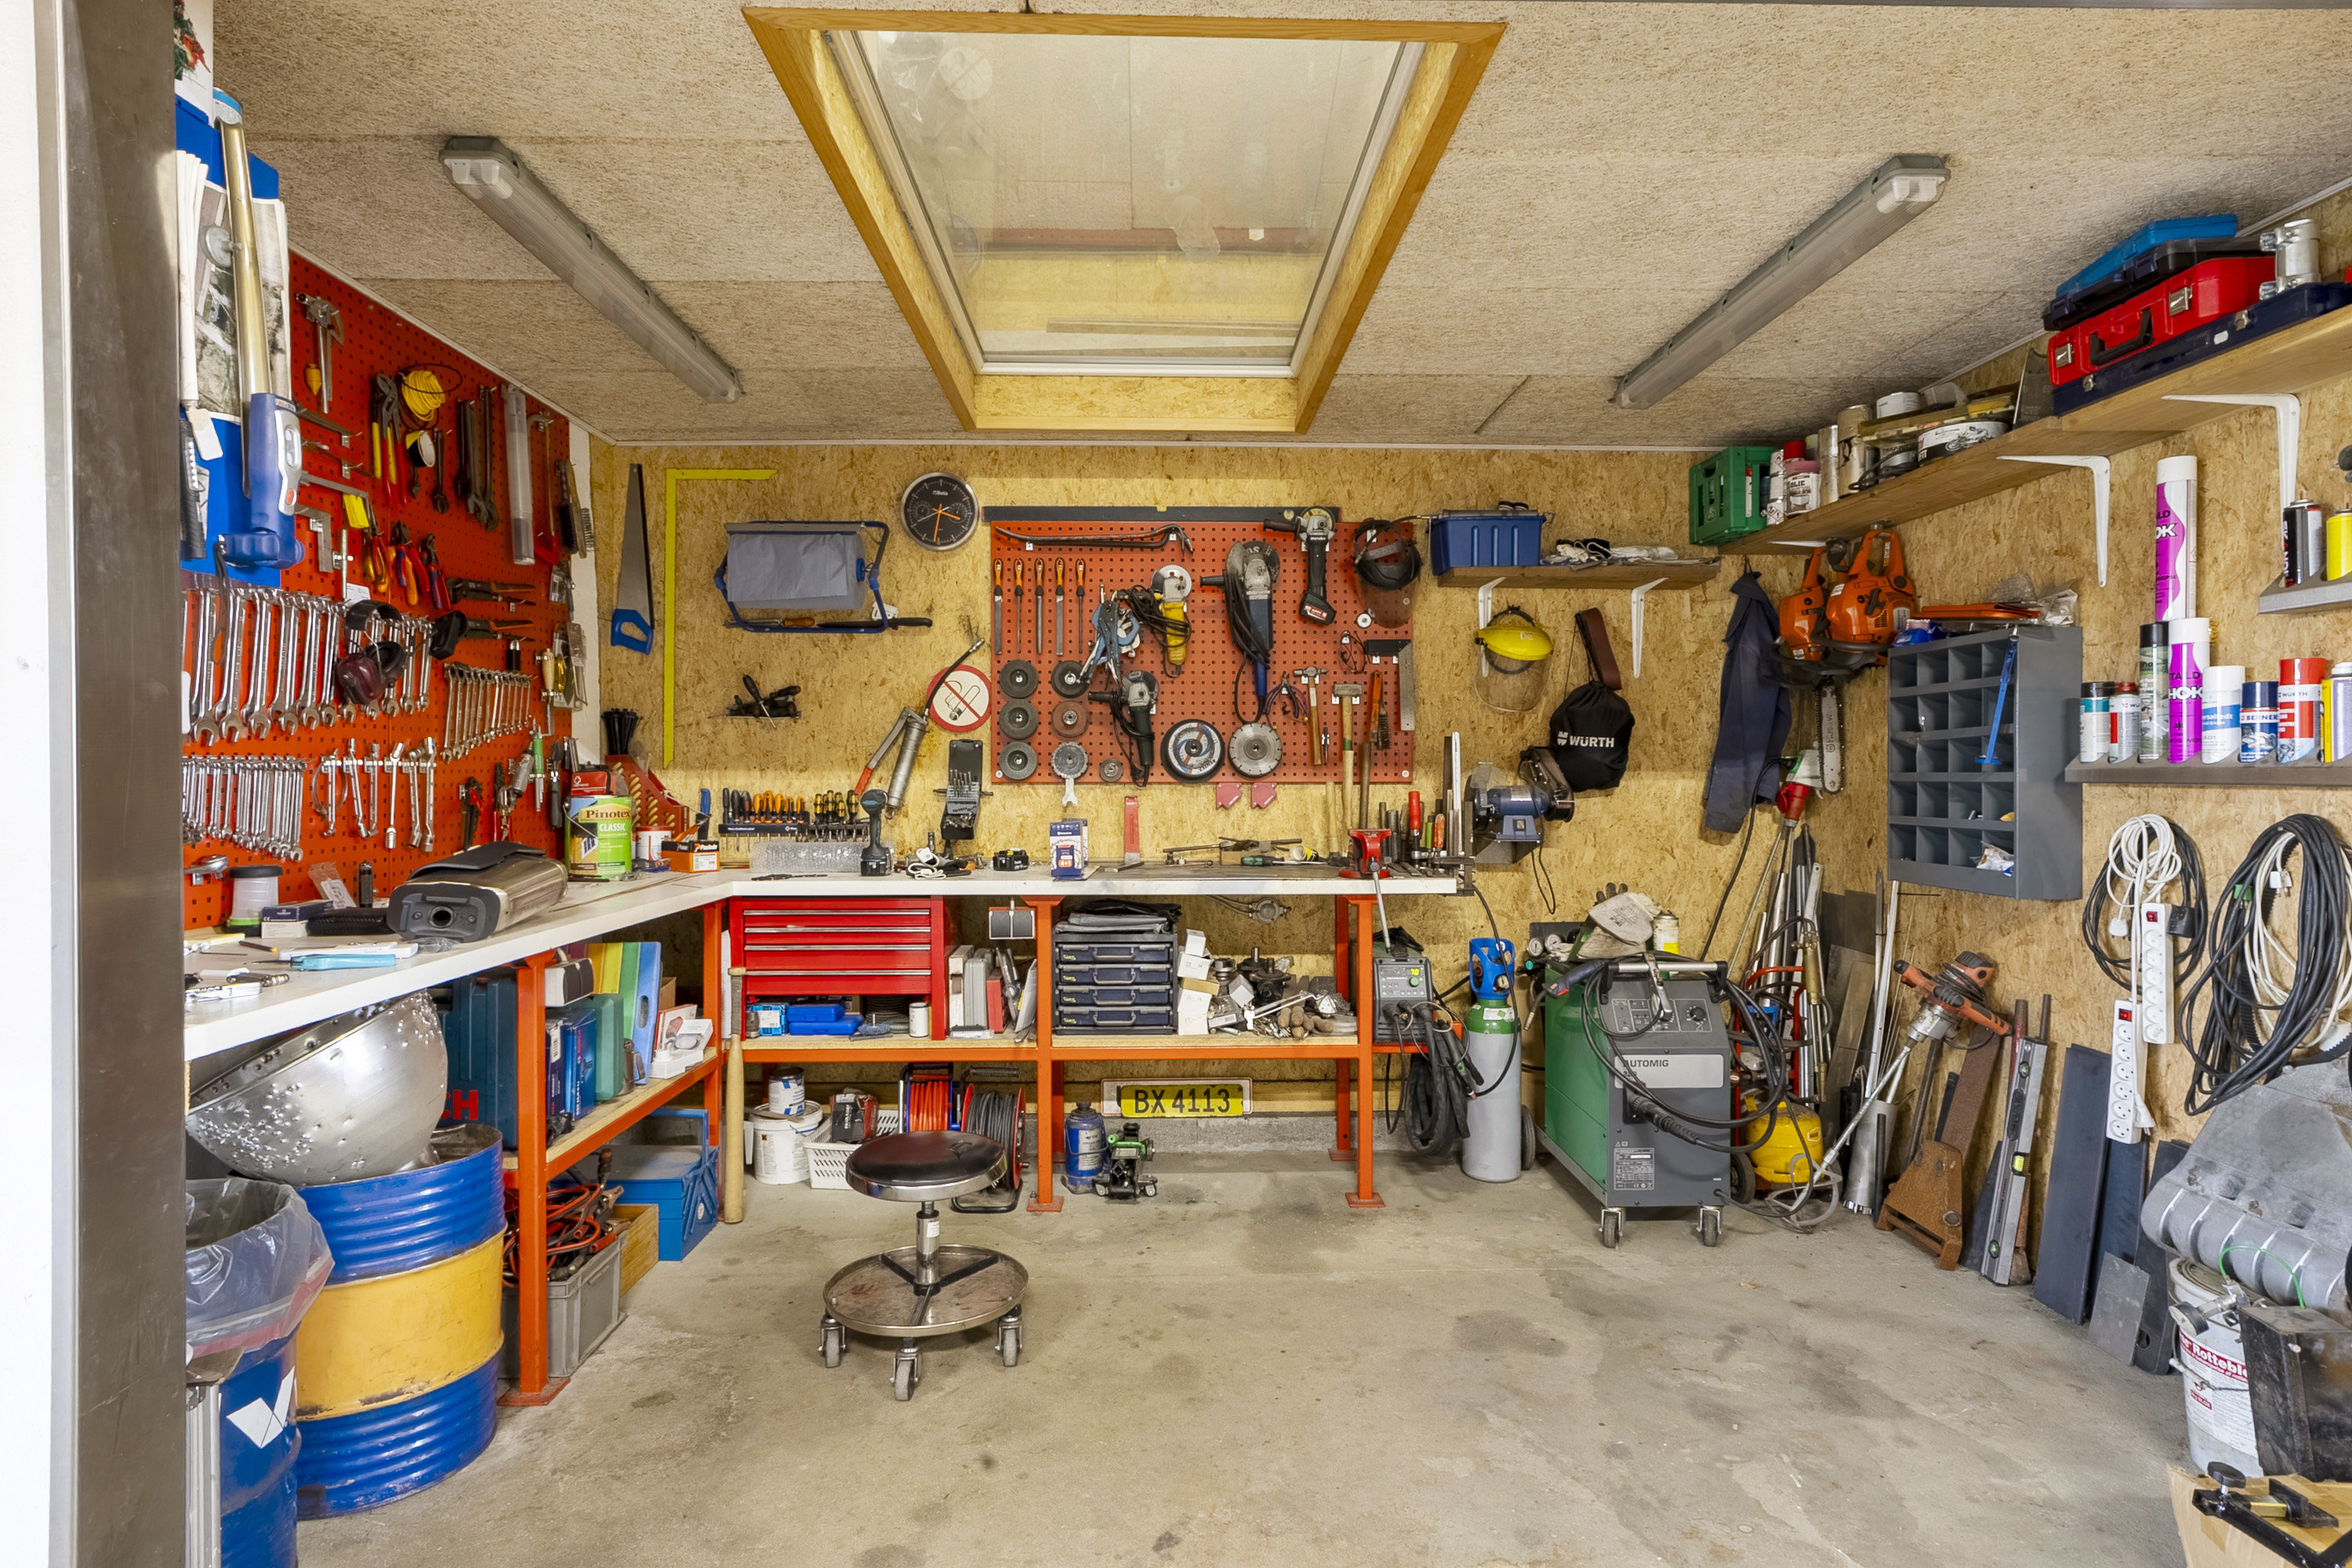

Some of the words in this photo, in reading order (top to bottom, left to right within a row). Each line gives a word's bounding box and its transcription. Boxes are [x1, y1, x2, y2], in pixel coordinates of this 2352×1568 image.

[2157, 510, 2171, 520] LD
[2155, 523, 2178, 539] OK
[2169, 686, 2203, 700] HOK
[1570, 735, 1615, 748] WÜRTH
[586, 810, 630, 819] Pinotex
[599, 822, 626, 832] CLASSIC
[1623, 1059, 1669, 1068] AUTOMIG
[1134, 1089, 1166, 1114] BX
[1171, 1087, 1230, 1113] 4113
